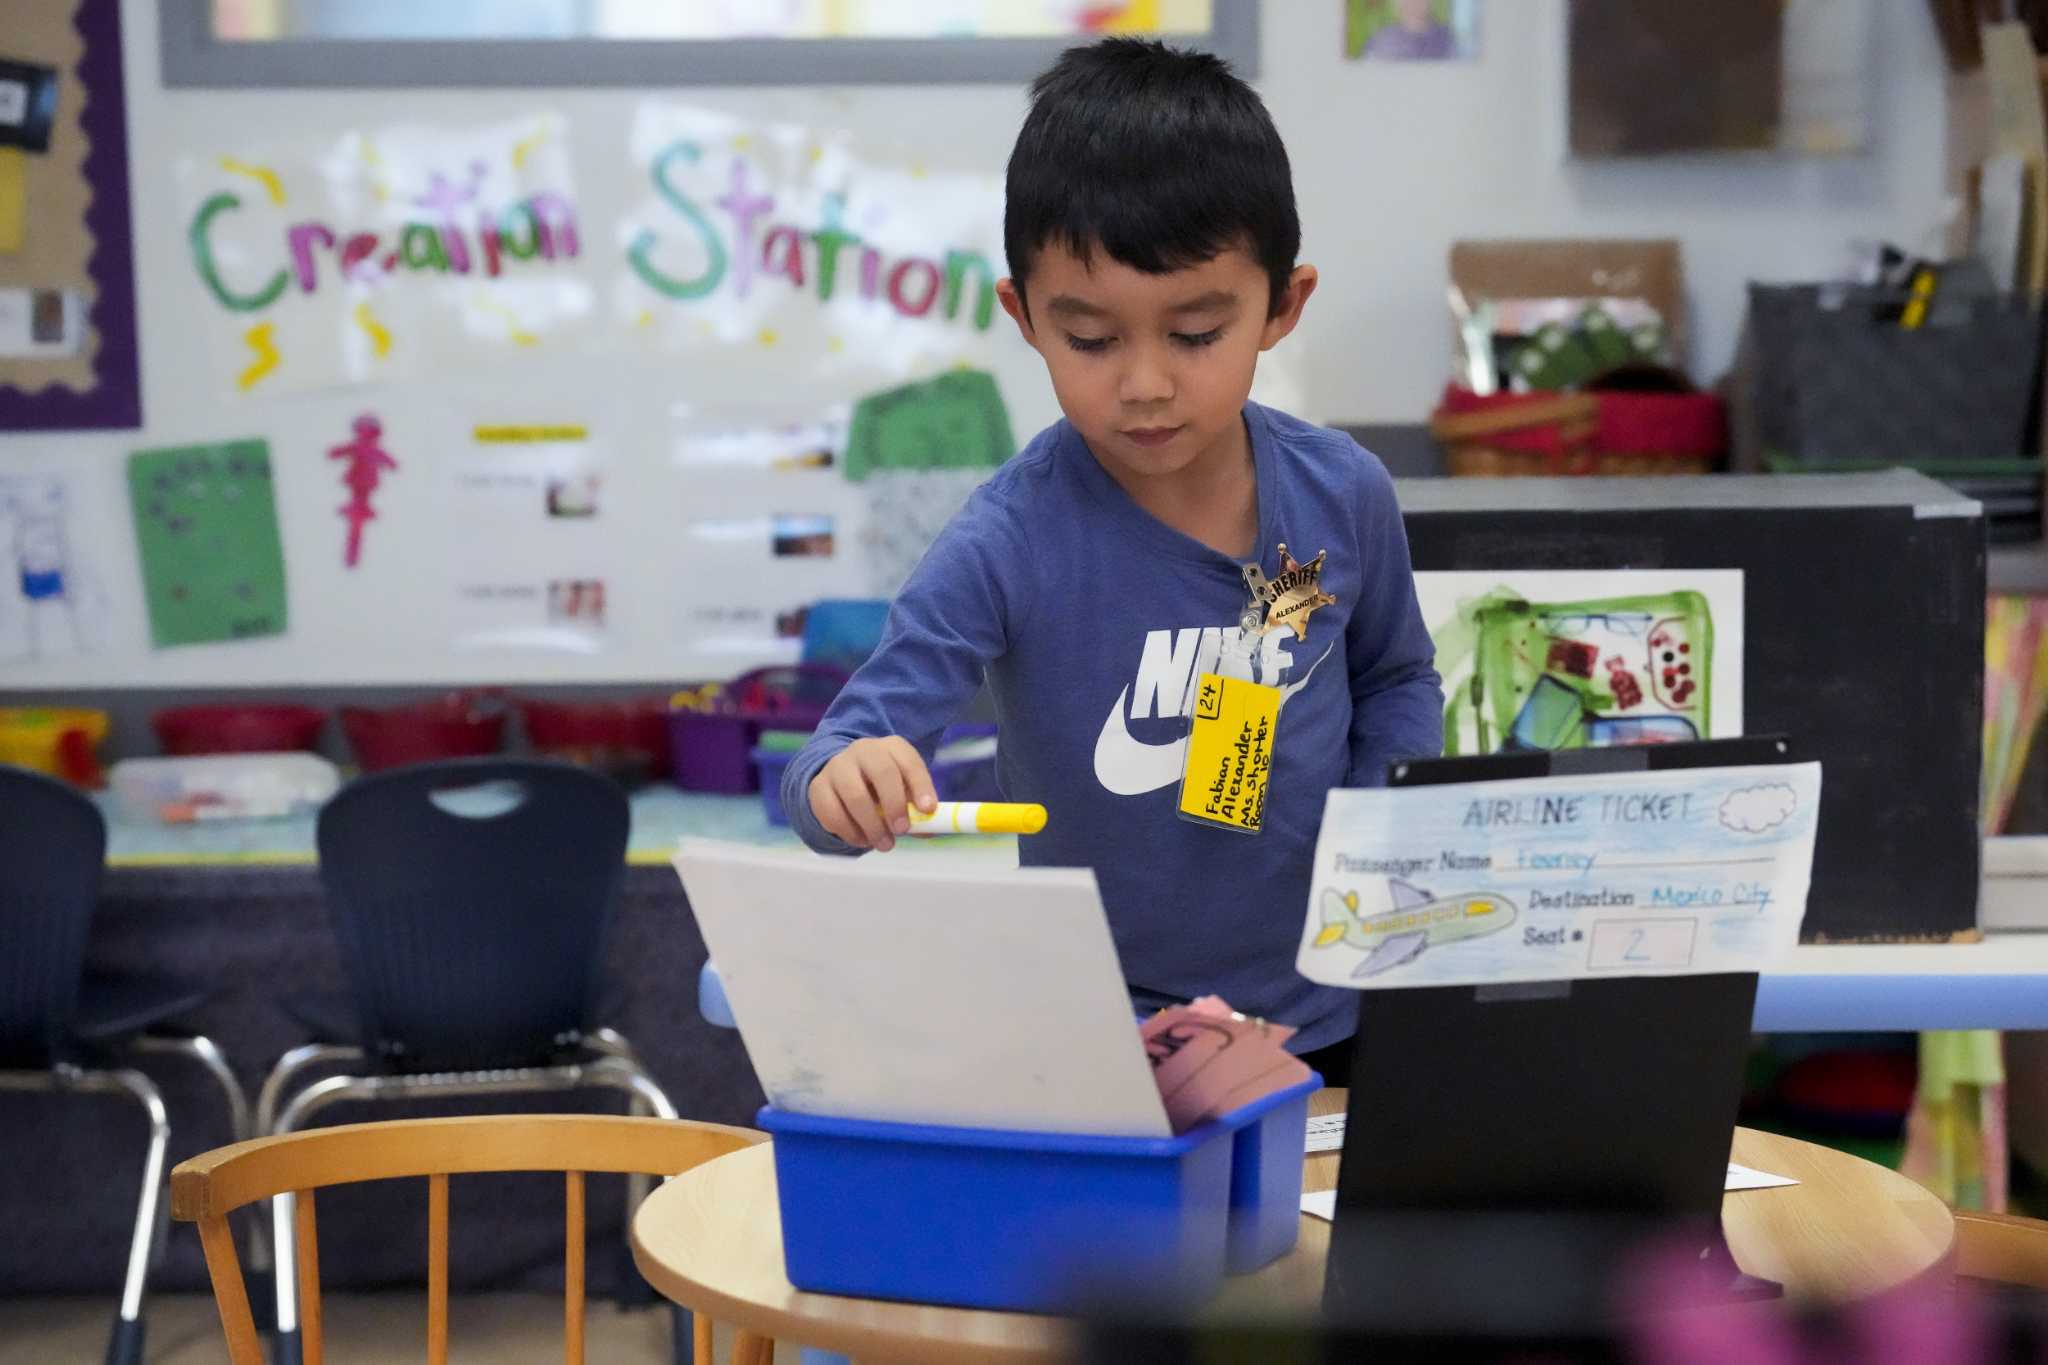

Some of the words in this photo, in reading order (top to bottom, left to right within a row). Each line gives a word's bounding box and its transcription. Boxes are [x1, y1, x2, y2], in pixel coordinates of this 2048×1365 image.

[188, 162, 579, 312] Creation
[628, 140, 997, 331] Station
[1276, 594, 1319, 619] ALEXANDER
[1200, 684, 1216, 711] 24
[1206, 756, 1231, 814] Fabian
[1221, 721, 1252, 819] Alexander
[1241, 795, 1253, 827] Ms.
[1463, 796, 1584, 827] AIRLINE
[1601, 793, 1694, 823] TICKET
[1439, 850, 1492, 872] Name
[1528, 889, 1634, 909] Destination
[1651, 885, 1723, 907] Mexico
[1733, 882, 1771, 912] City
[1523, 926, 1565, 946] Seat
[1623, 929, 1650, 961] 2
